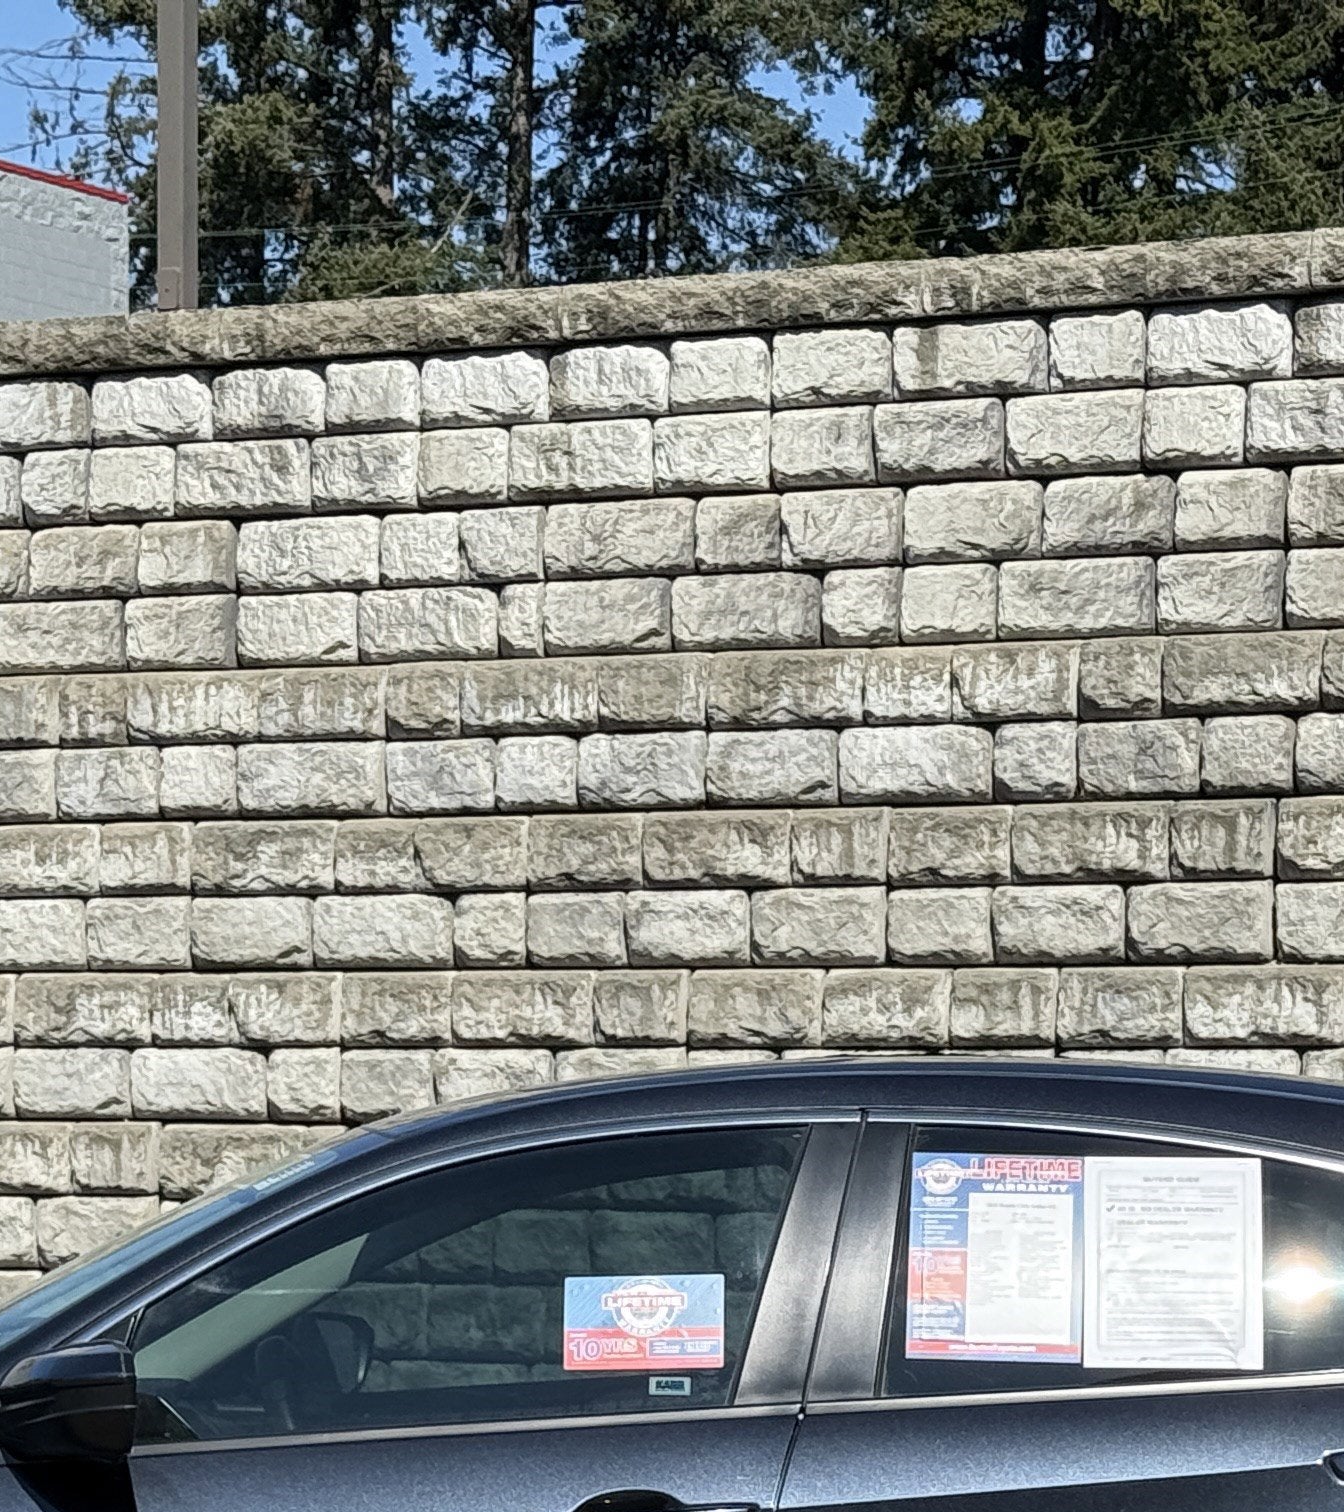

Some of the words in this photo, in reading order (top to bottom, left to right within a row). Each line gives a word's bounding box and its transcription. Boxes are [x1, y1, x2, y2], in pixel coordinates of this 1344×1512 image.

[970, 1157, 1083, 1182] LIFETIME
[982, 1183, 1069, 1193] WARRANTY
[606, 1296, 683, 1308] LIFETIME
[569, 1337, 601, 1362] 10
